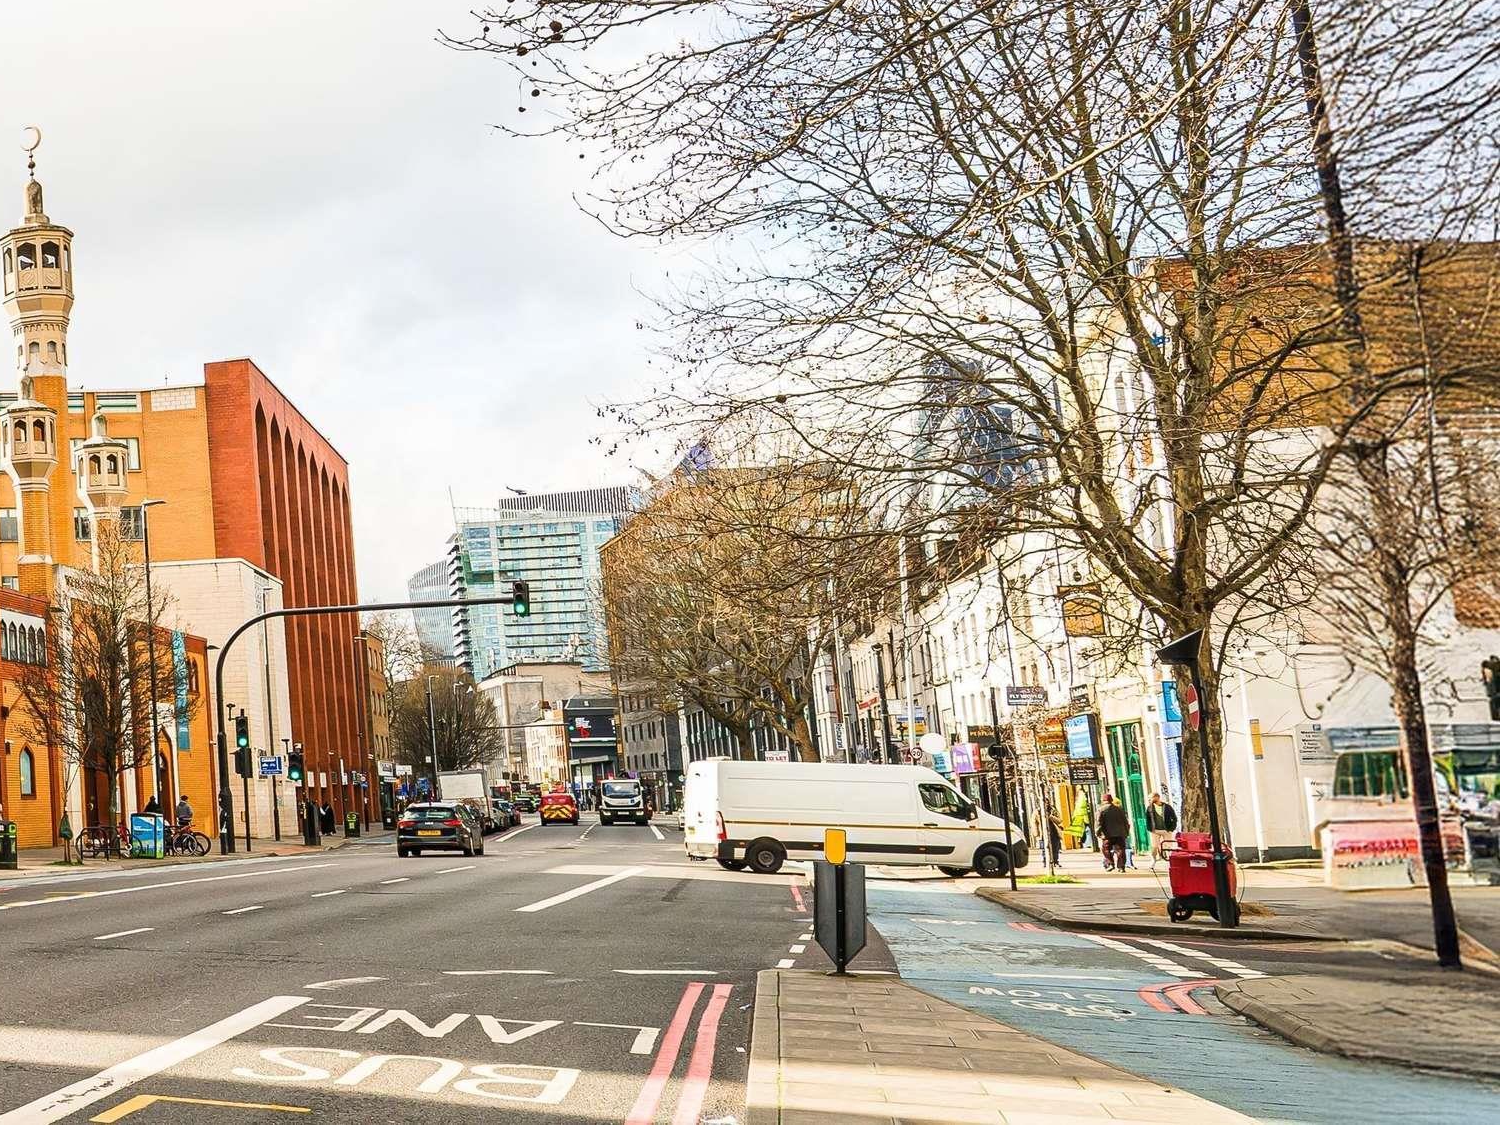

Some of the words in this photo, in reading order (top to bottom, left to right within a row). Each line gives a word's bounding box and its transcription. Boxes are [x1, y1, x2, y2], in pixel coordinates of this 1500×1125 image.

[968, 985, 1116, 1004] SLOW
[261, 1003, 662, 1055] LANE
[232, 1046, 582, 1105] BUS
